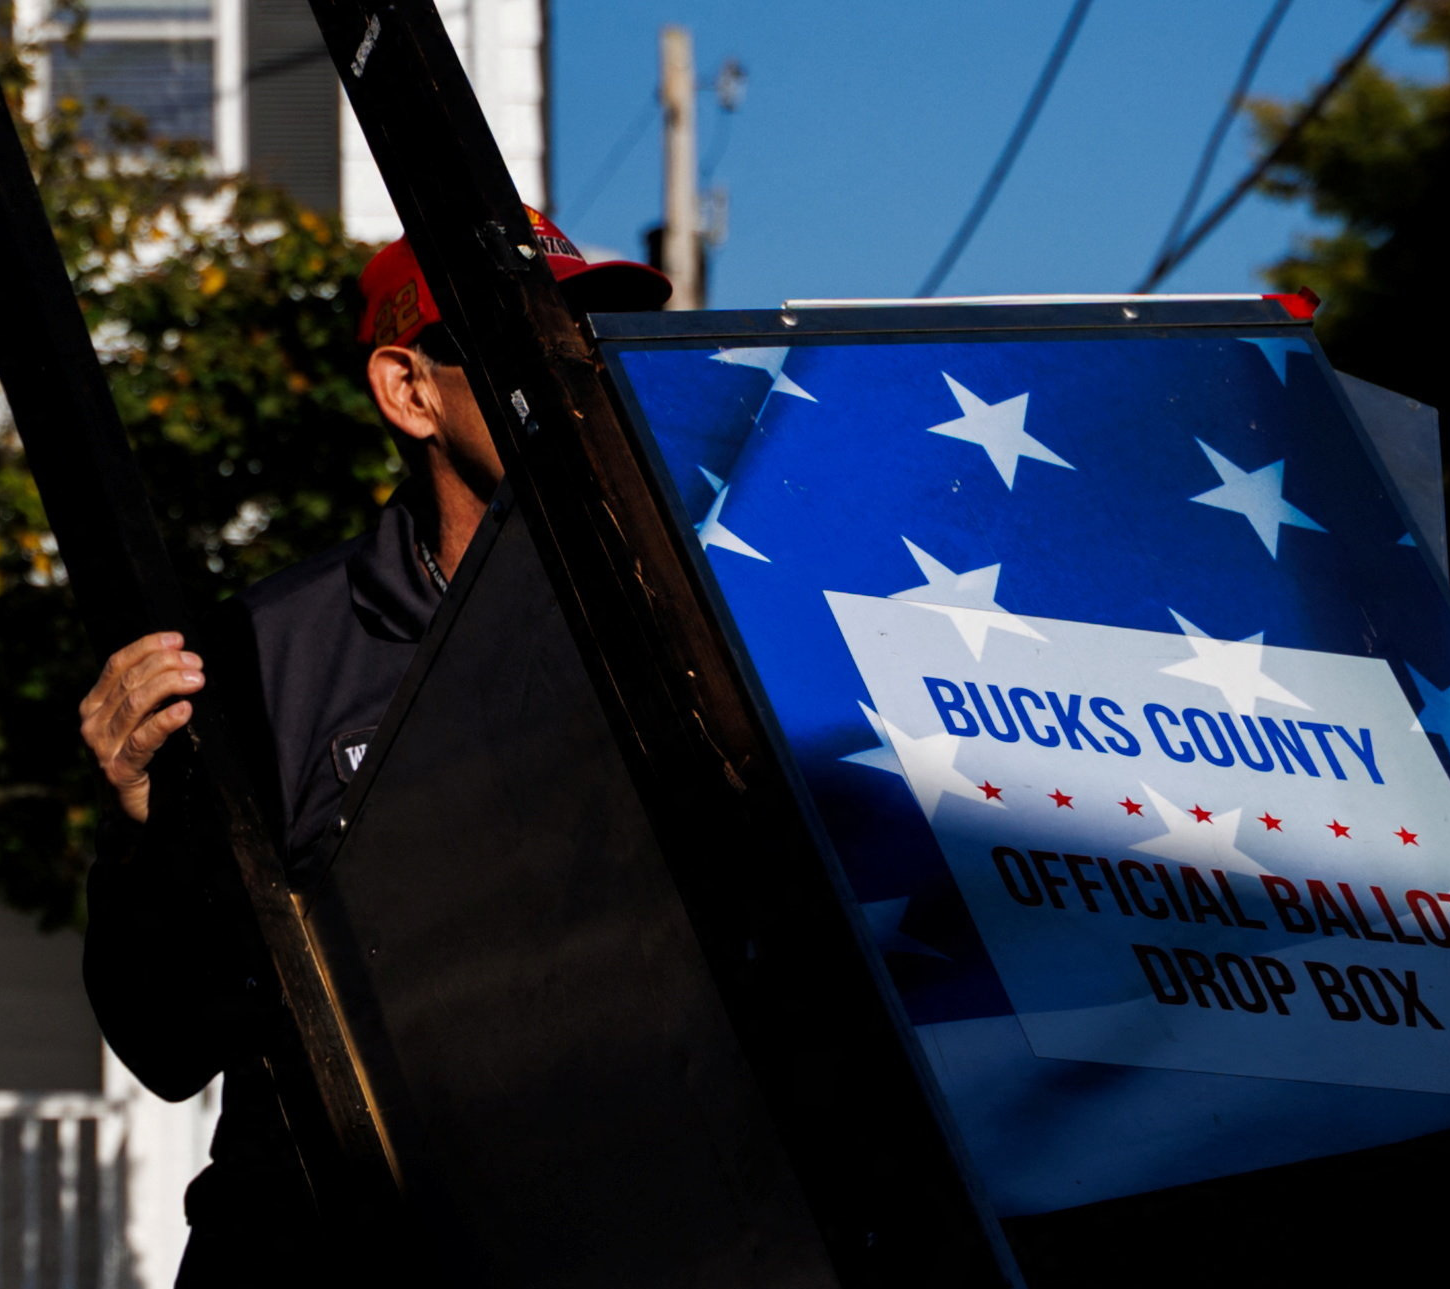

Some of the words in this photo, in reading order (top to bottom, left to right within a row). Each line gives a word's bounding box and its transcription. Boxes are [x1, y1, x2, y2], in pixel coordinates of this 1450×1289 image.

[374, 281, 420, 346] 22
[923, 676, 1141, 757] BUCKS
[1143, 703, 1385, 784] COUNTY
[992, 846, 1266, 930] OFFICIAL
[1133, 943, 1296, 1015] DROP
[1304, 960, 1445, 1030] BOX
